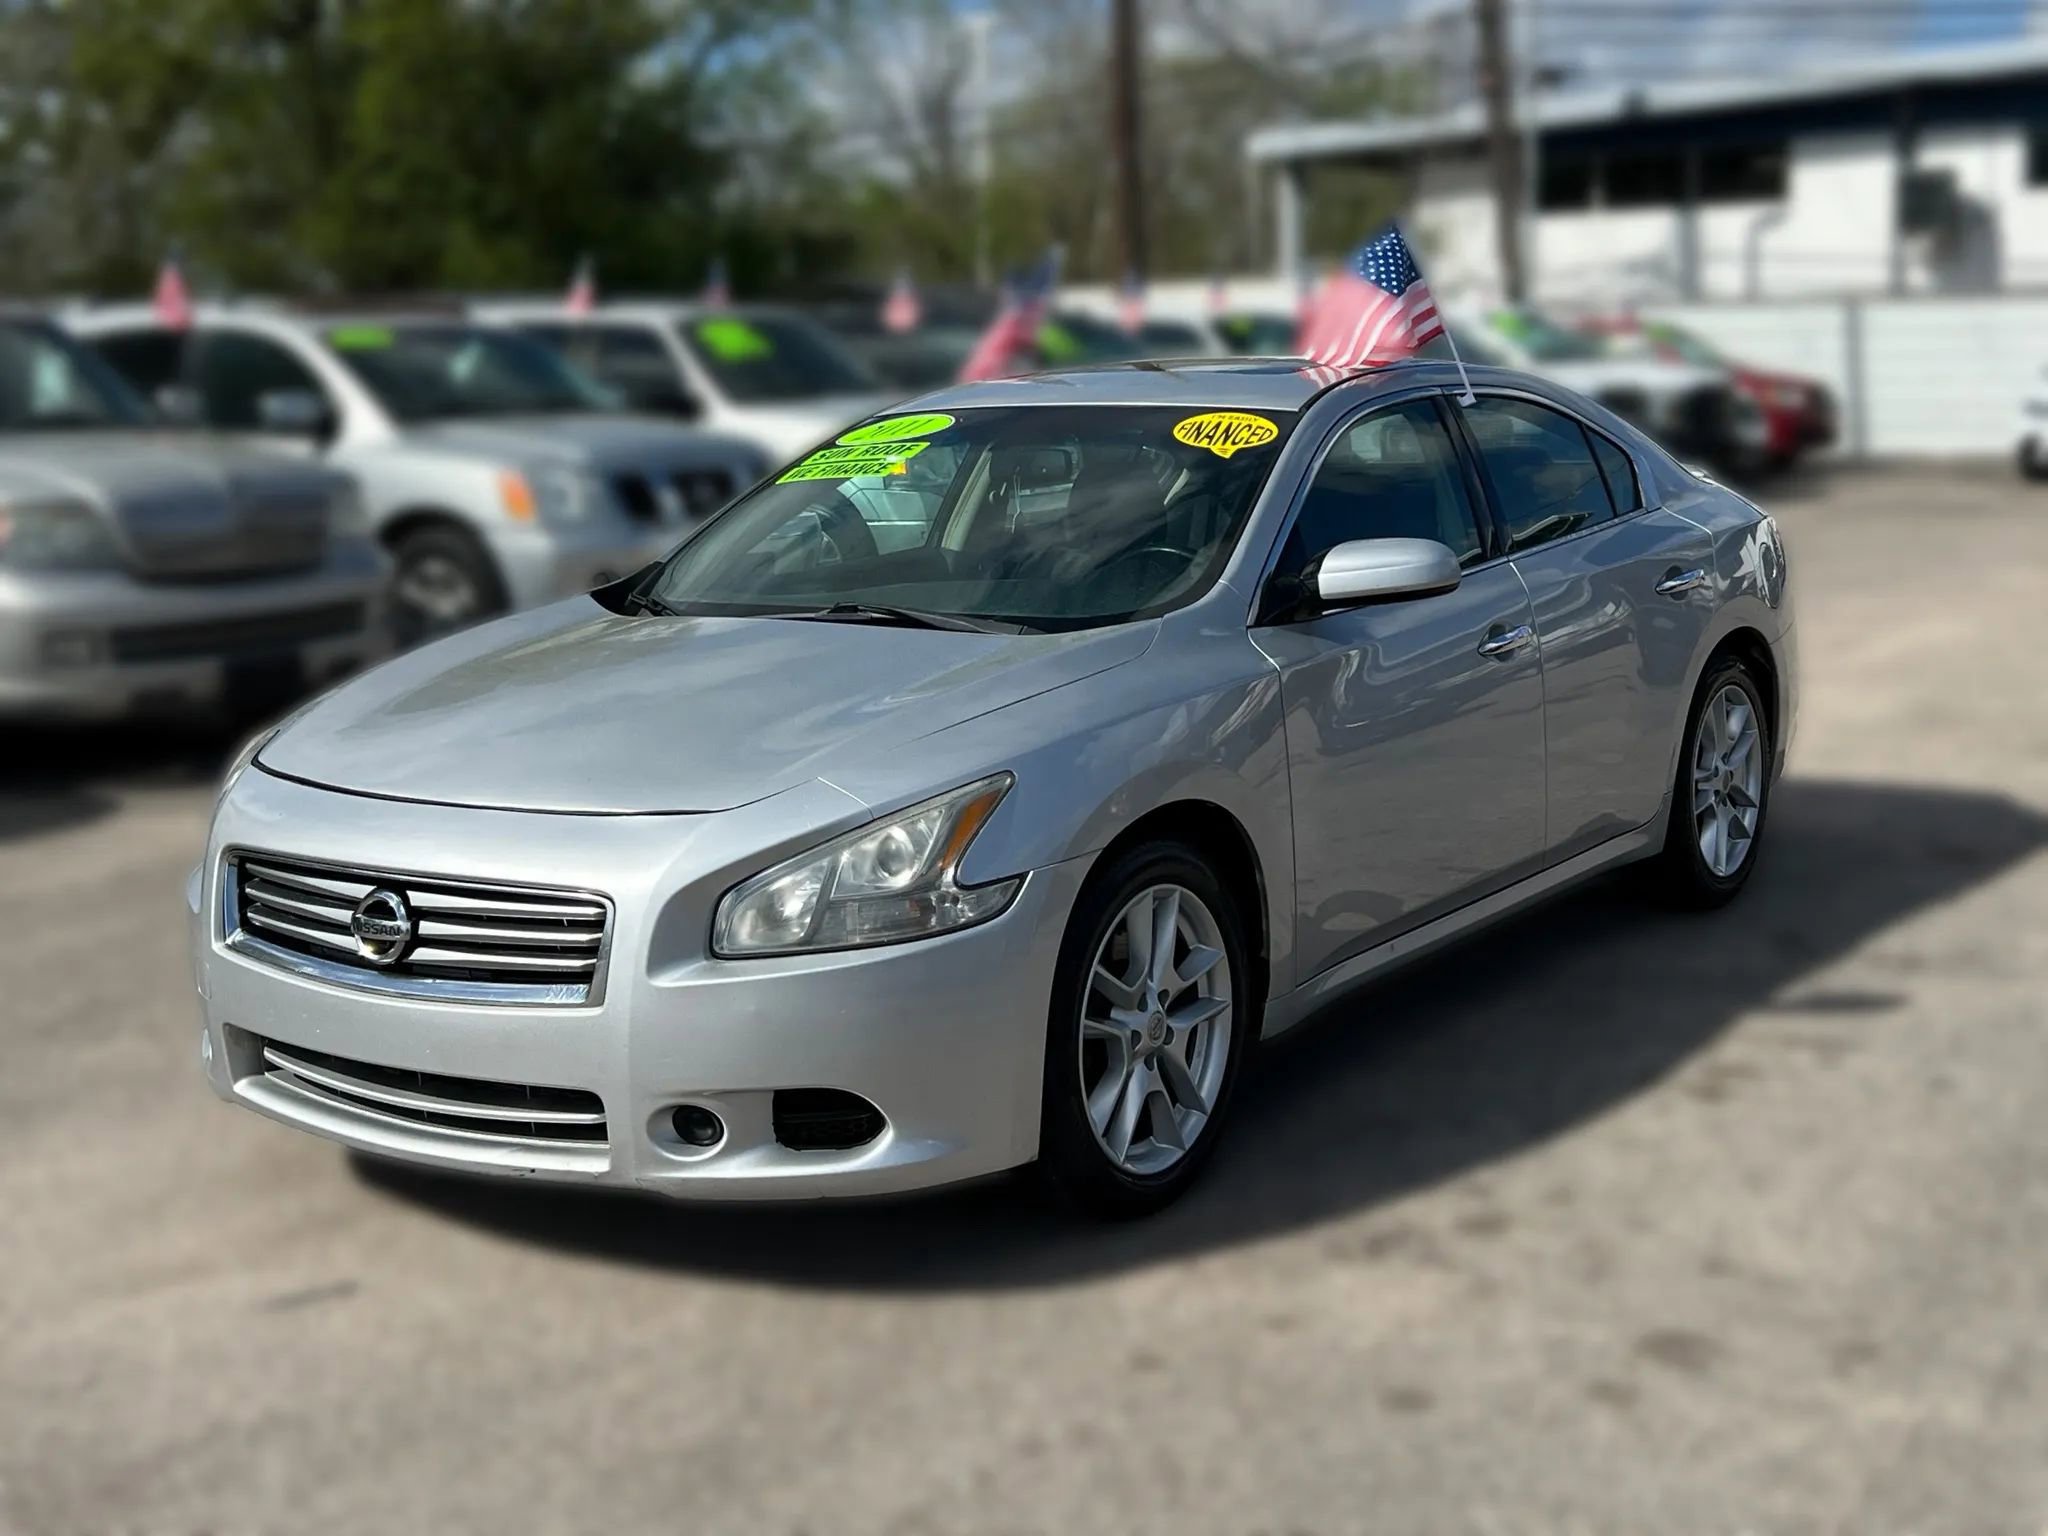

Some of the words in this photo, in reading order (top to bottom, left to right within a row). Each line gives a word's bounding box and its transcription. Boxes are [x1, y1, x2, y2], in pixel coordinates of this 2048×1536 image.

[1177, 420, 1274, 446] FINANCED
[811, 447, 861, 462] SUN
[857, 444, 920, 457] ROOF
[784, 466, 819, 481] WE
[814, 463, 889, 478] FINANCE
[352, 918, 402, 937] NISSAN
